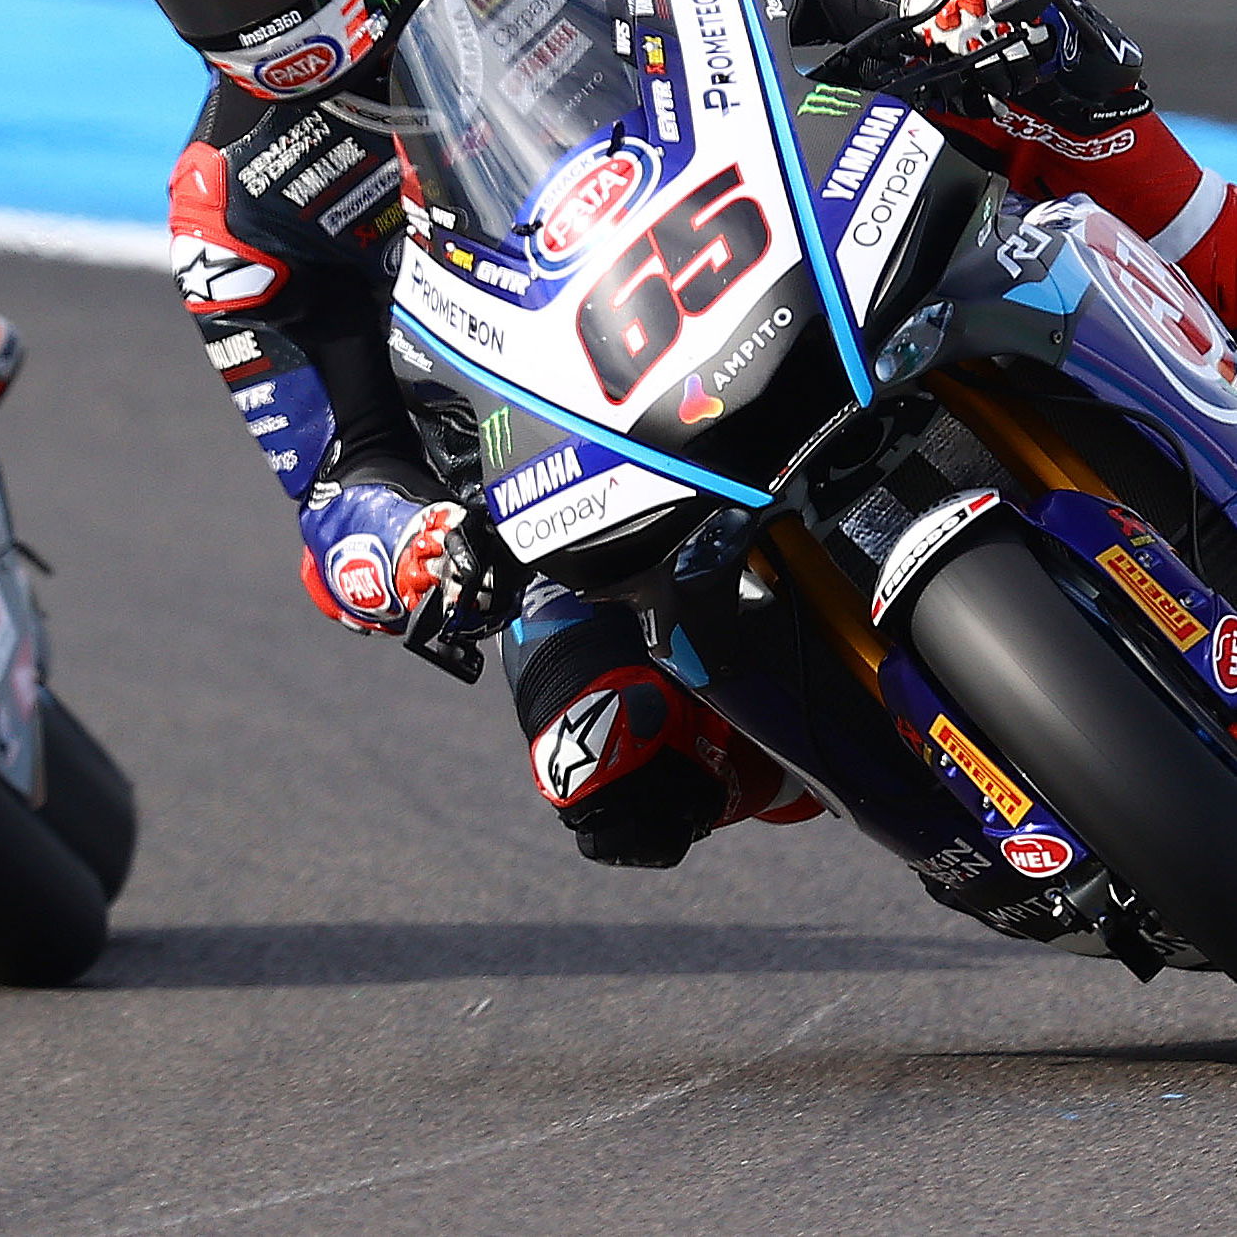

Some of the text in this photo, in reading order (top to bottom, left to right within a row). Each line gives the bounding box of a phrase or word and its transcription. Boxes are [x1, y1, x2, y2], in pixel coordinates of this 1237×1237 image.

[239, 10, 303, 47] Insta360
[270, 52, 328, 85] PATA
[822, 106, 905, 201] YAMAHA
[547, 167, 629, 247] PATA
[411, 258, 504, 355] PROMETEON
[576, 162, 772, 406] 65
[713, 306, 793, 392] AMPITO
[493, 446, 583, 518] YAMAHA
[1107, 554, 1199, 642] PIRELLI
[938, 725, 1022, 815] PIRELLI
[1011, 850, 1061, 869] HEL
